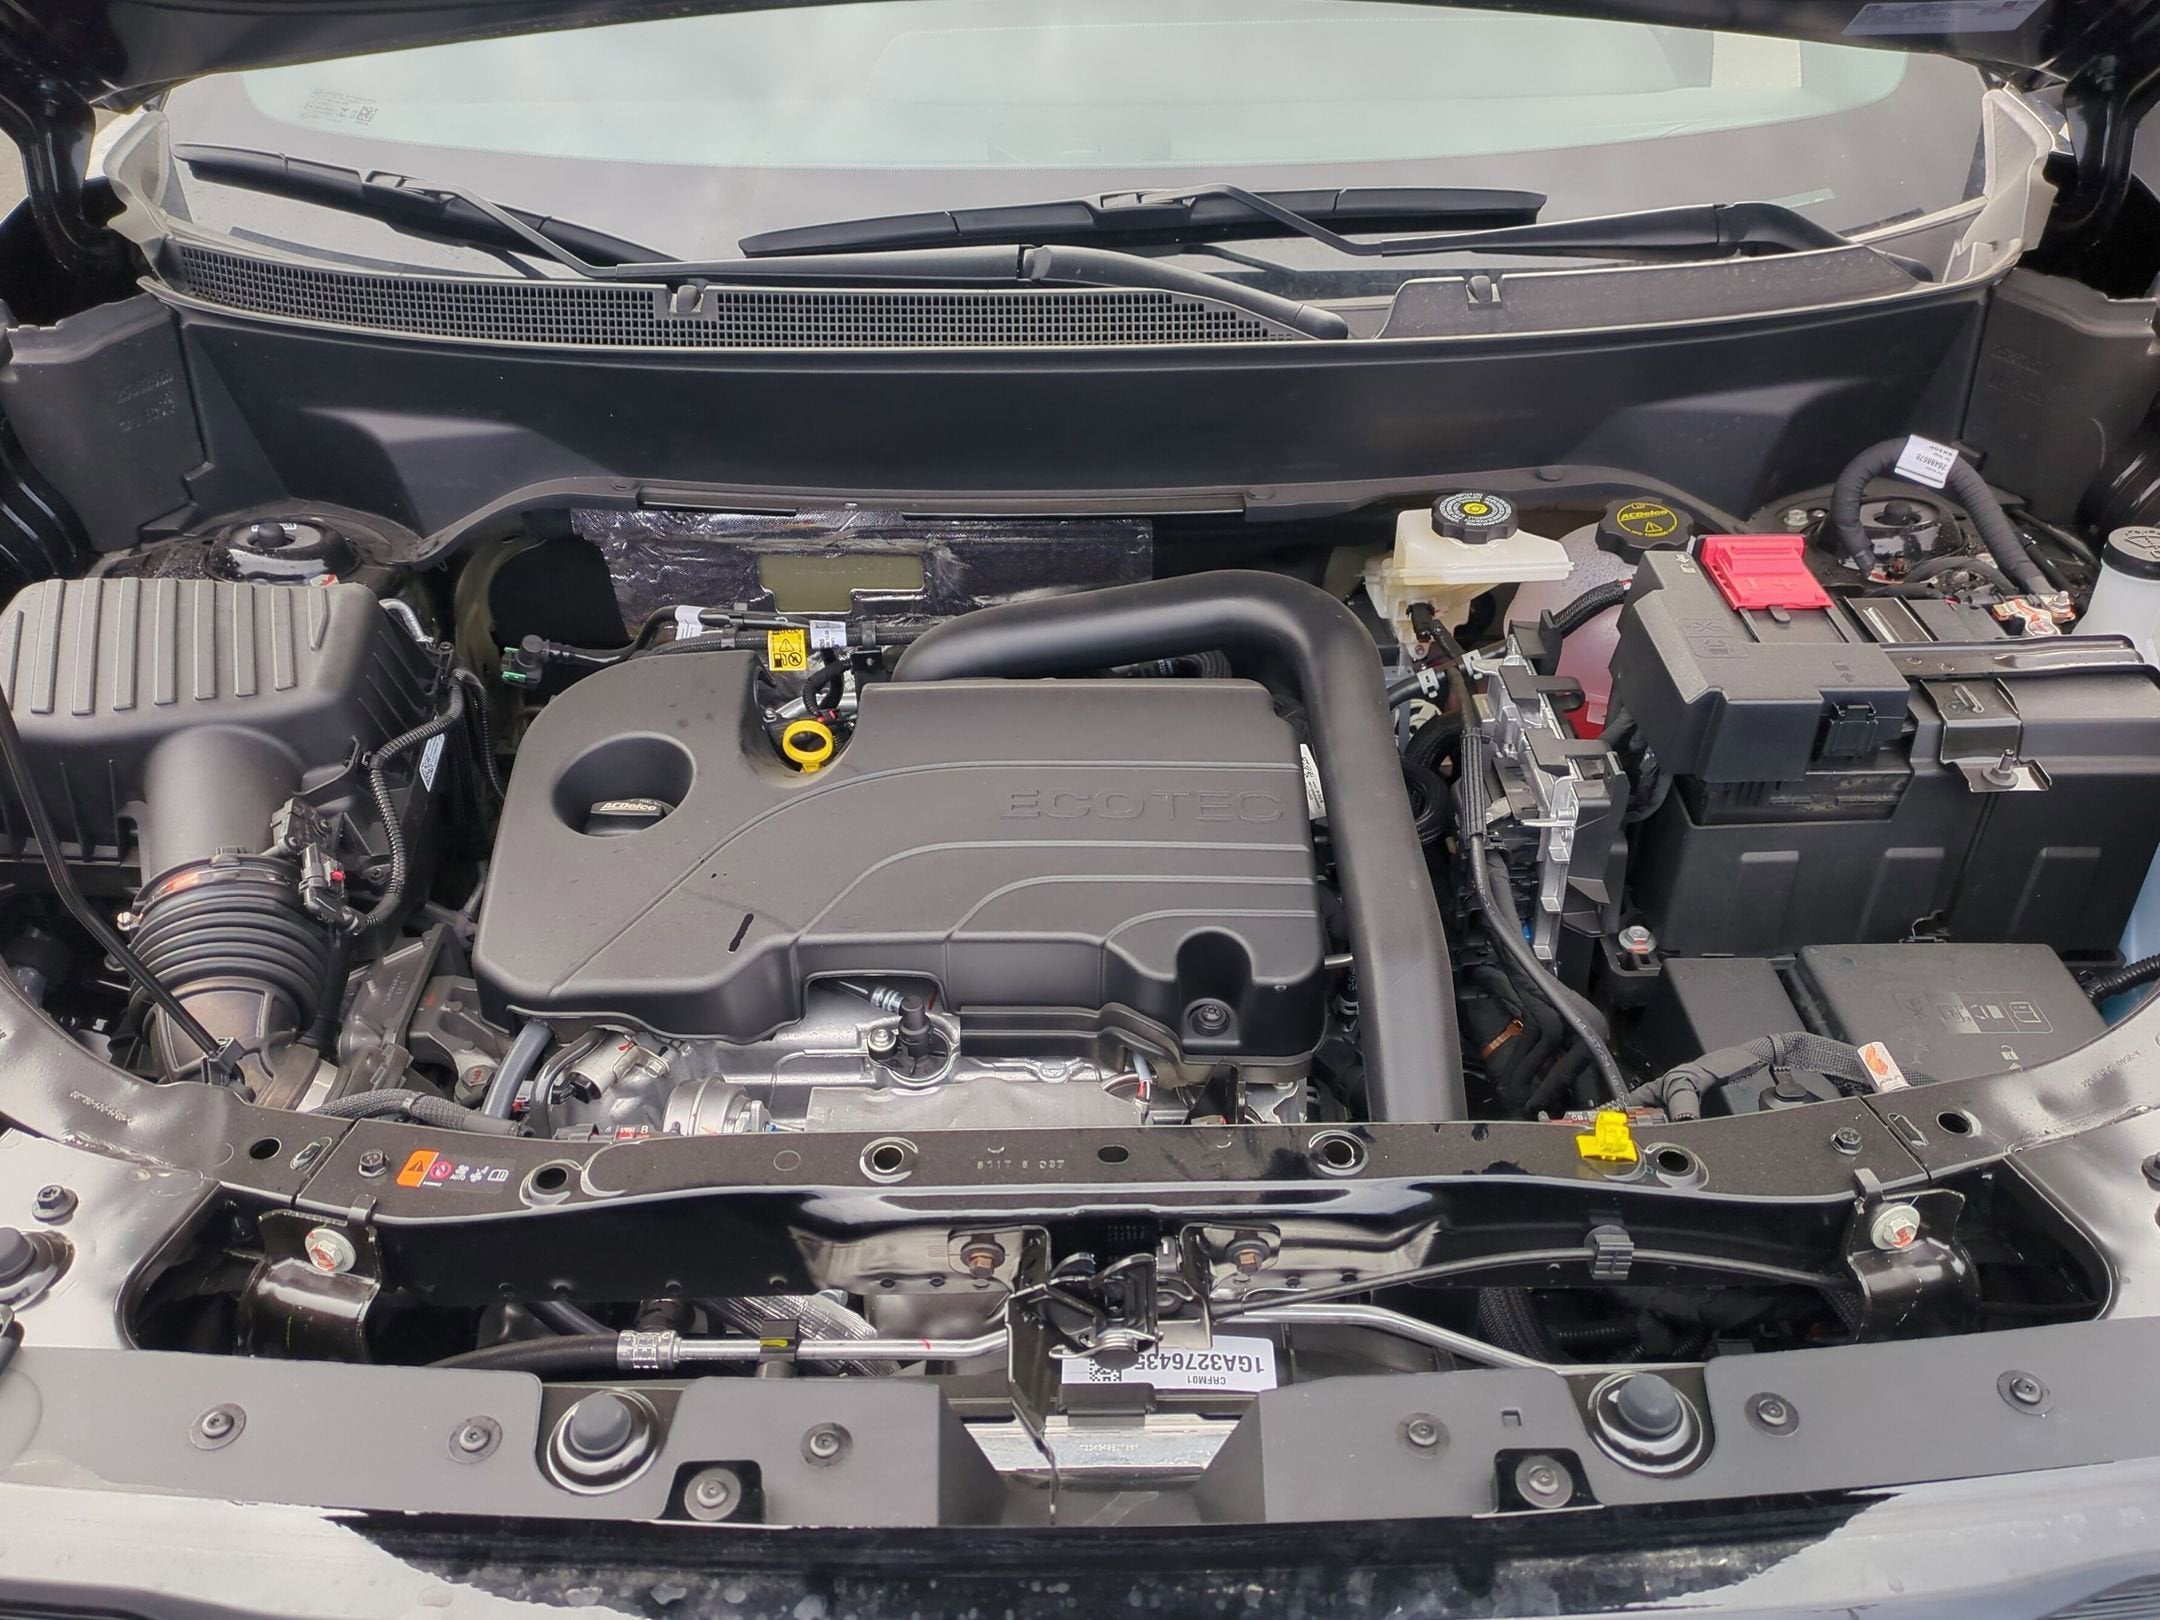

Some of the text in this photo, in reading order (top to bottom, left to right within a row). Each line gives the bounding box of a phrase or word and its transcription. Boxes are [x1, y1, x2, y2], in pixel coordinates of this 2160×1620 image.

[1620, 510, 1668, 521] ACDelco
[600, 802, 657, 811] ACDelco
[1000, 788, 1284, 823] ECOTEC
[449, 1173, 466, 1181] AUTO
[1134, 1352, 1265, 1374] 1GA3276435
[1187, 1375, 1226, 1386] CRFM01
